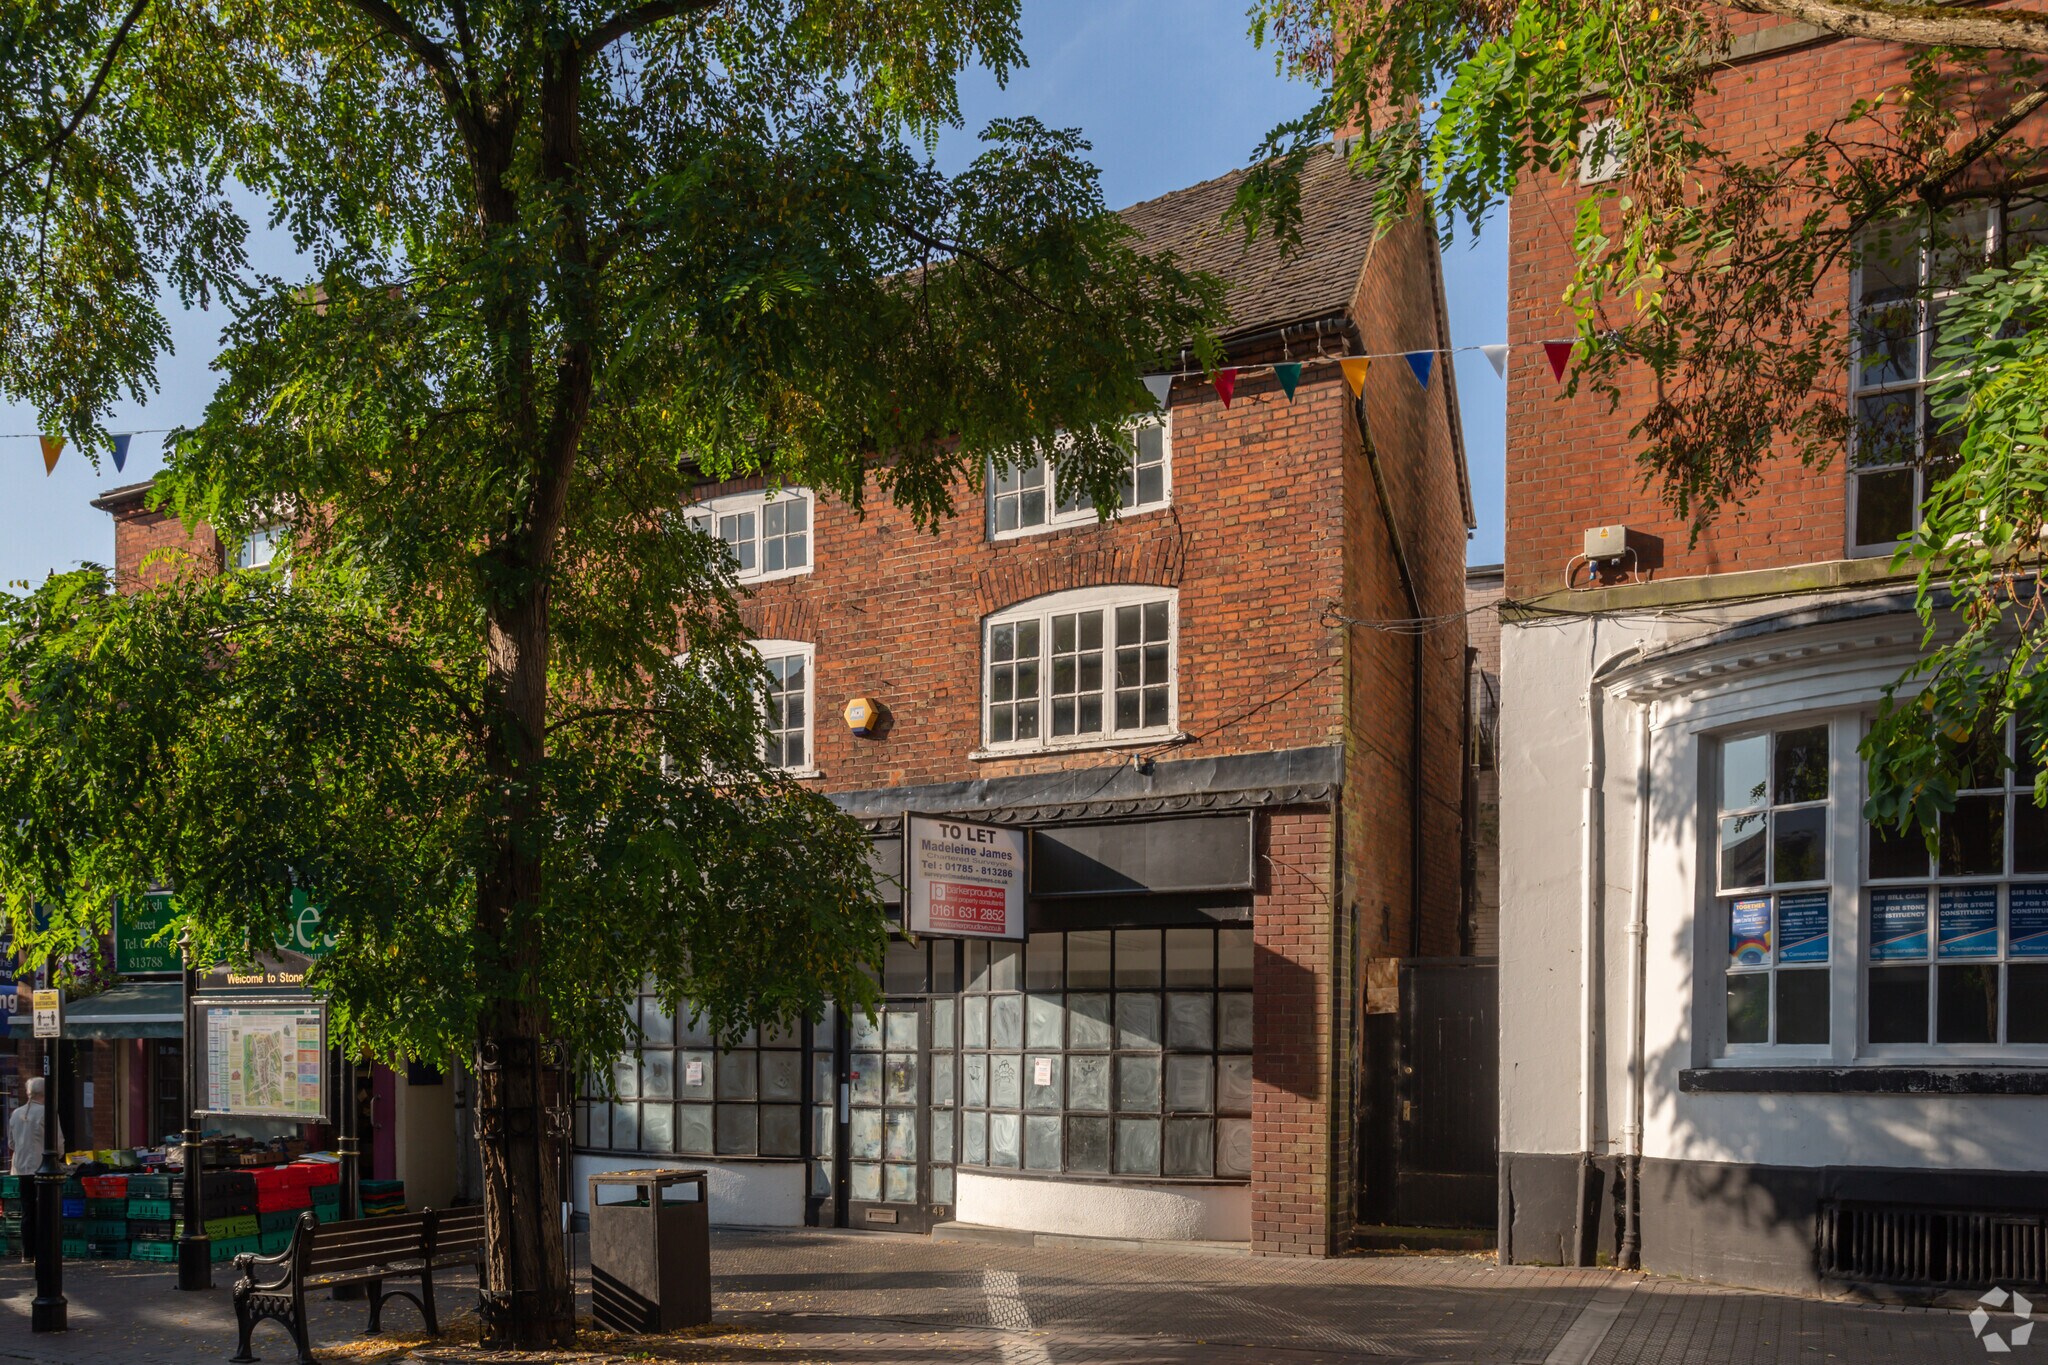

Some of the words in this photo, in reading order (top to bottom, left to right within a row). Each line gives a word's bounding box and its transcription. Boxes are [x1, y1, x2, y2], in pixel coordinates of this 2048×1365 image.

[939, 824, 961, 839] TO
[967, 827, 996, 844] LET
[921, 839, 977, 856] Madeleine
[980, 846, 1013, 861] James
[926, 852, 970, 863] Chartered
[972, 857, 1008, 868] Surveyor
[921, 860, 937, 870] Tel
[945, 863, 973, 874] 01785
[981, 867, 1013, 878] 813286
[931, 903, 955, 917] 0161
[958, 906, 977, 919] 631
[980, 908, 1004, 921] 2852
[1735, 902, 1766, 911] TOGETHER
[1902, 903, 1926, 911] STONE
[1940, 908, 1995, 917] CONSTITUENCY
[1872, 911, 1926, 919] CONSTITUENCY
[129, 956, 163, 968] 813788
[227, 973, 264, 984] Welcome
[267, 972, 276, 983] to
[279, 972, 304, 983] Stone
